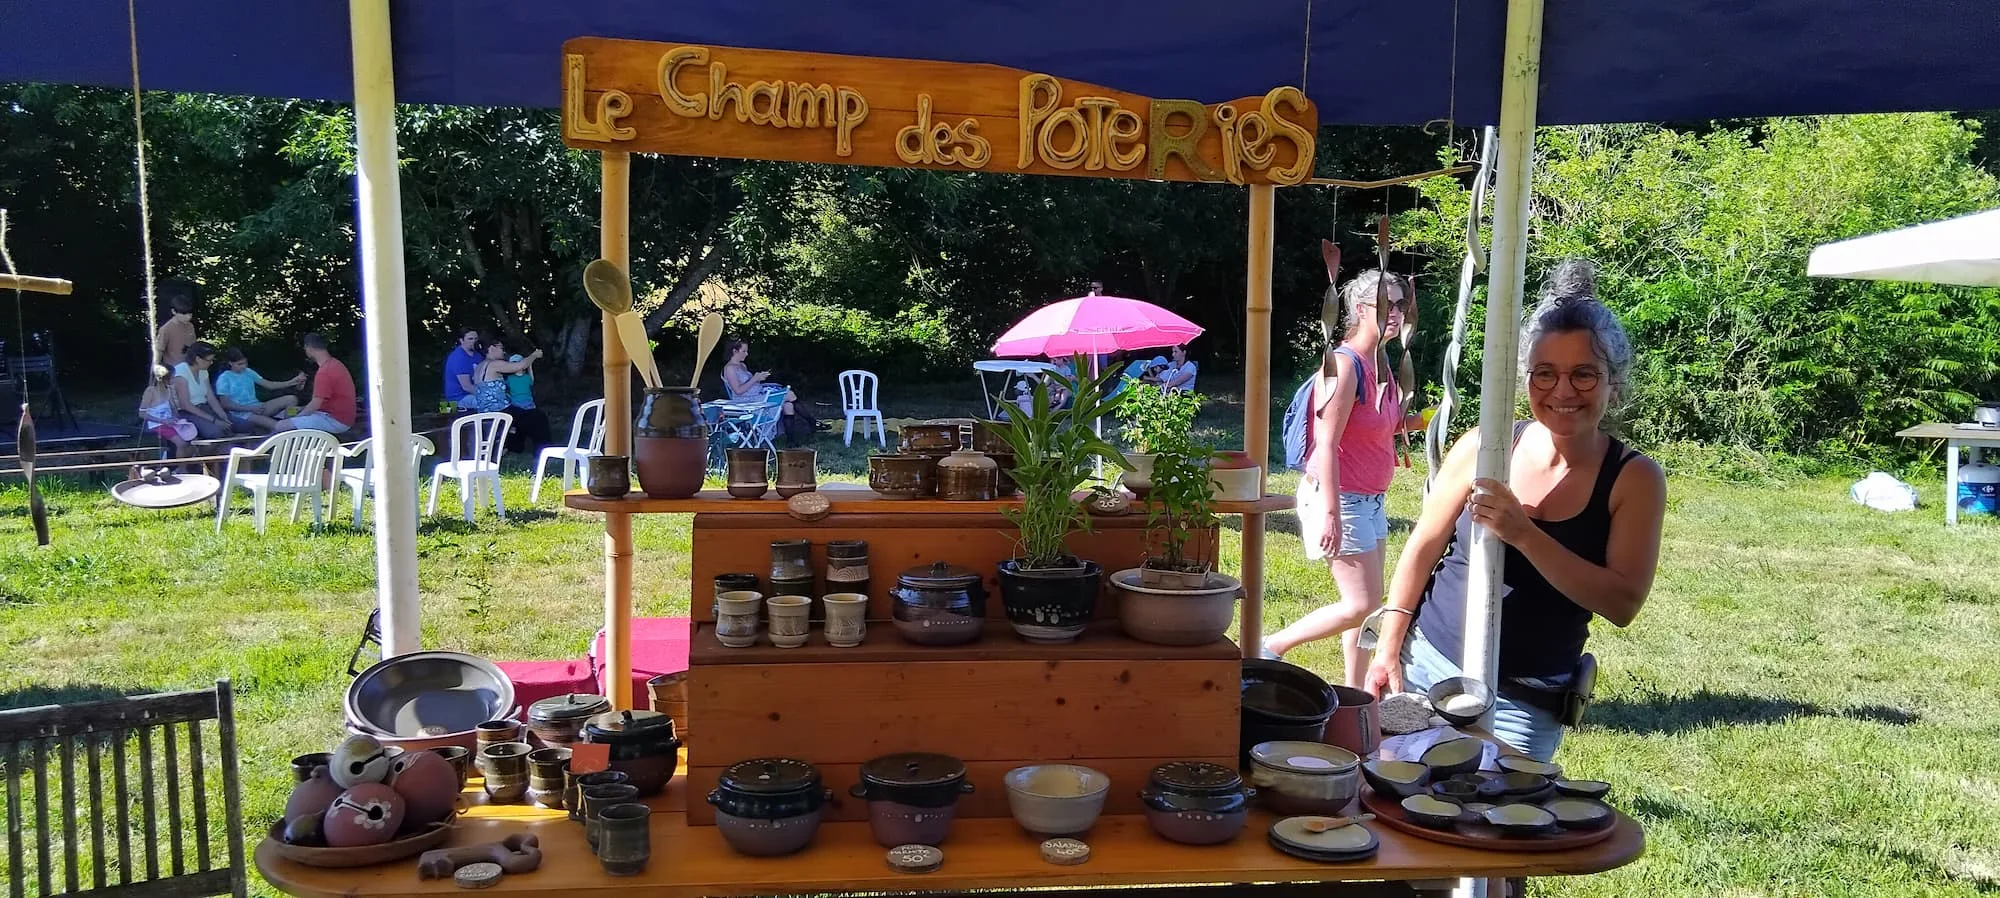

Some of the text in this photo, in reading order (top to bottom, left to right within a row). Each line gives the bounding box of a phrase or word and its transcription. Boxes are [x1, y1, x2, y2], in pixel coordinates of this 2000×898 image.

[566, 53, 637, 142] Le
[658, 45, 869, 157] Champ
[895, 93, 992, 169] des
